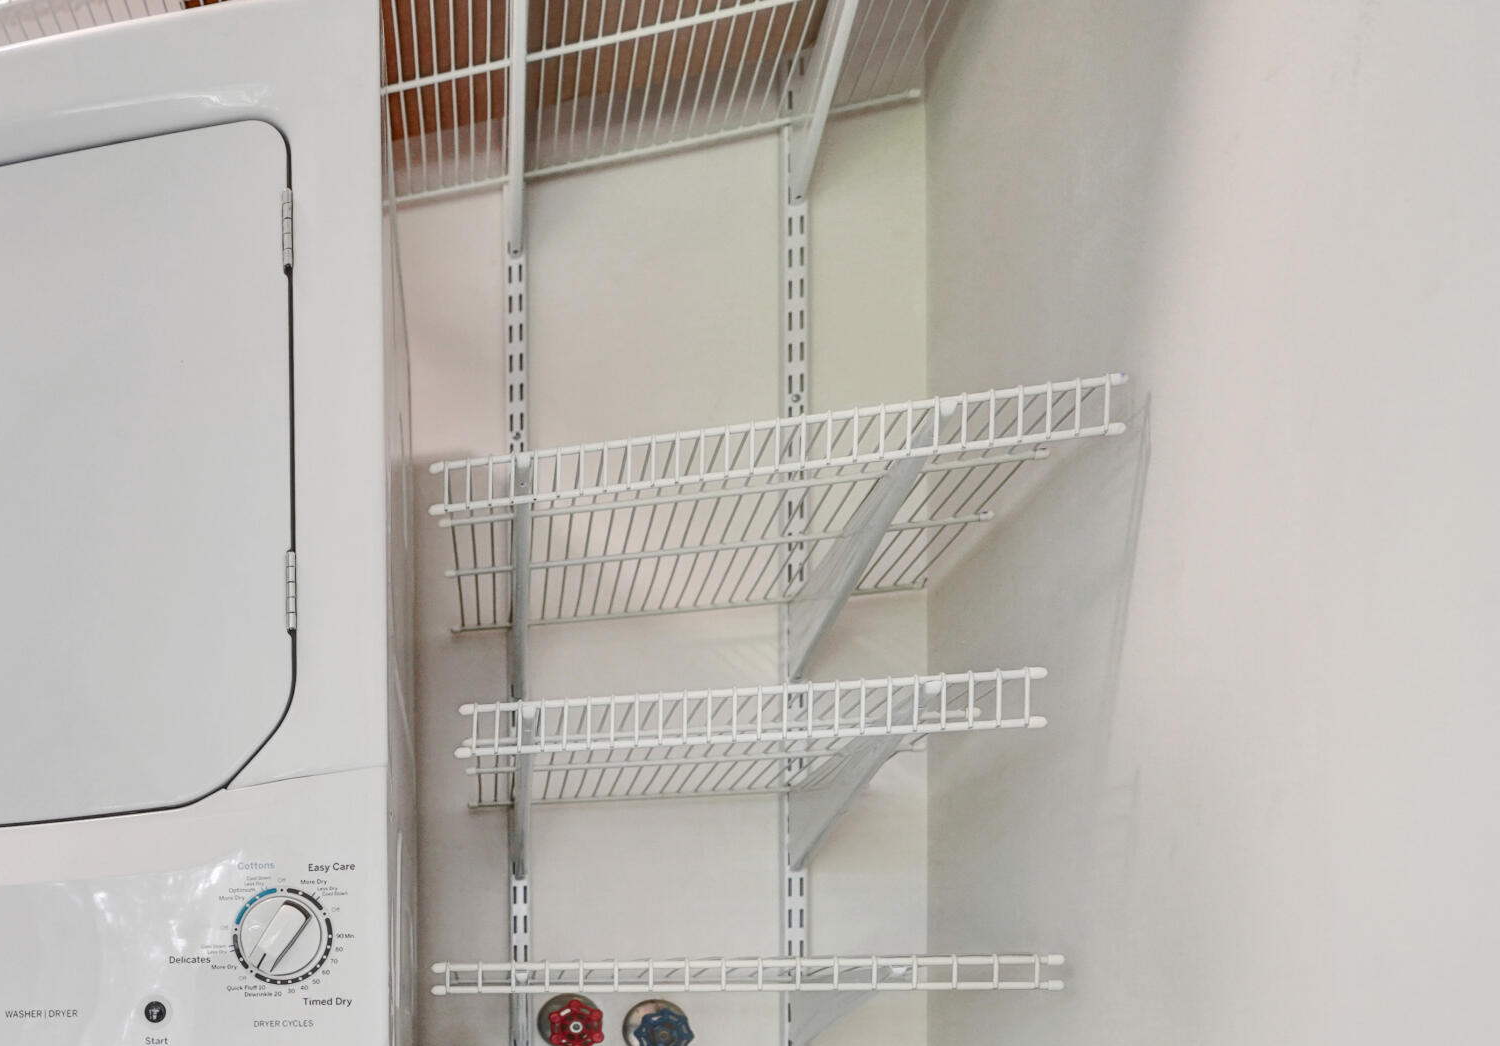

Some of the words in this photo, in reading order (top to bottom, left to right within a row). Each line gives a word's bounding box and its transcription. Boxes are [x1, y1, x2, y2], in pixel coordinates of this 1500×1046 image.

[237, 862, 275, 870] Cottons
[308, 863, 330, 873] Easy
[333, 862, 356, 871] Care
[169, 956, 211, 964] Delicates
[303, 997, 333, 1006] Timed
[335, 997, 353, 1007] Dry
[4, 1010, 42, 1018] WASHER
[48, 1009, 78, 1018] DRYER
[253, 1020, 280, 1028] DRYER
[282, 1020, 314, 1028] CYCLES
[145, 1036, 168, 1045] Start
